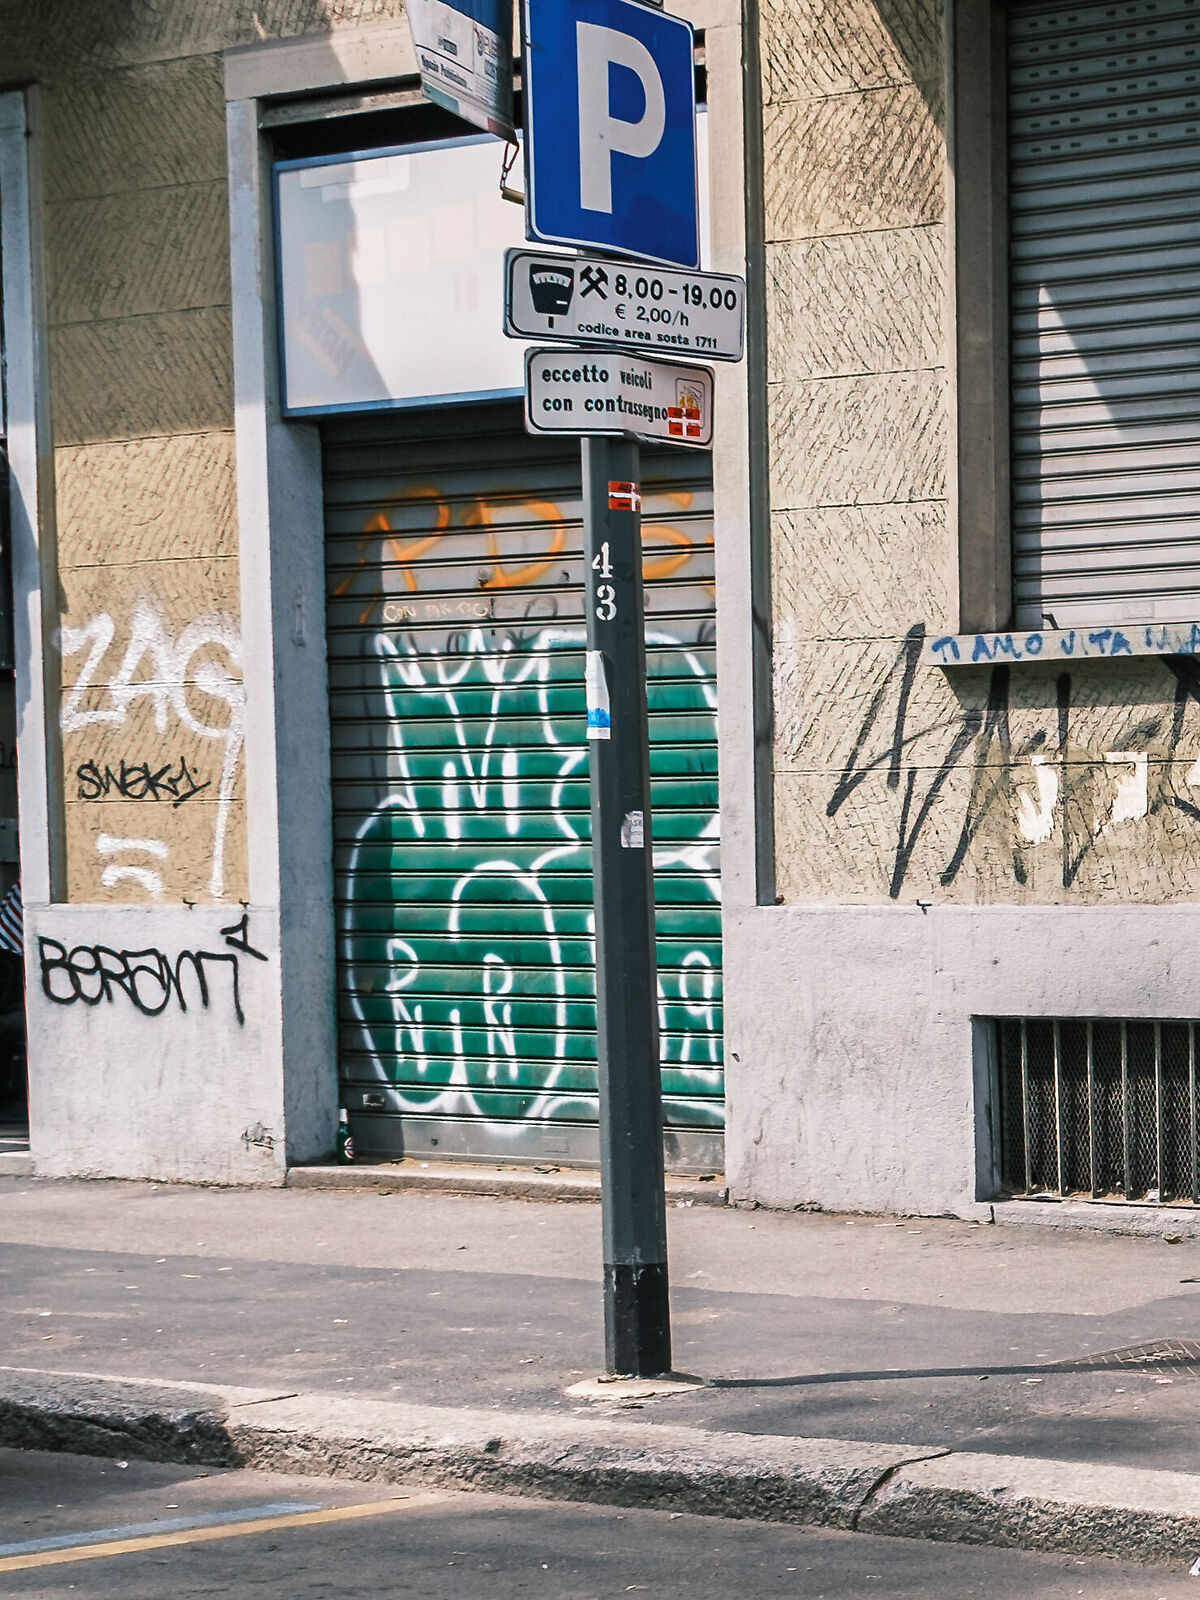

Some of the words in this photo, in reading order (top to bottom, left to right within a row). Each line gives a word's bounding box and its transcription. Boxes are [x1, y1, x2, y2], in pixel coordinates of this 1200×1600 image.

[576, 20, 666, 214] P
[615, 303, 626, 320] €
[636, 305, 689, 327] 2,00/h
[577, 322, 620, 337] codice
[624, 329, 651, 341] area
[657, 332, 690, 346] sosta
[695, 335, 718, 349] 1711
[542, 364, 610, 383] eccetto
[620, 368, 652, 390] veicoli
[542, 398, 573, 412] con
[584, 395, 669, 423] contrassegno
[932, 636, 960, 663] TI
[972, 633, 1044, 662] AMO
